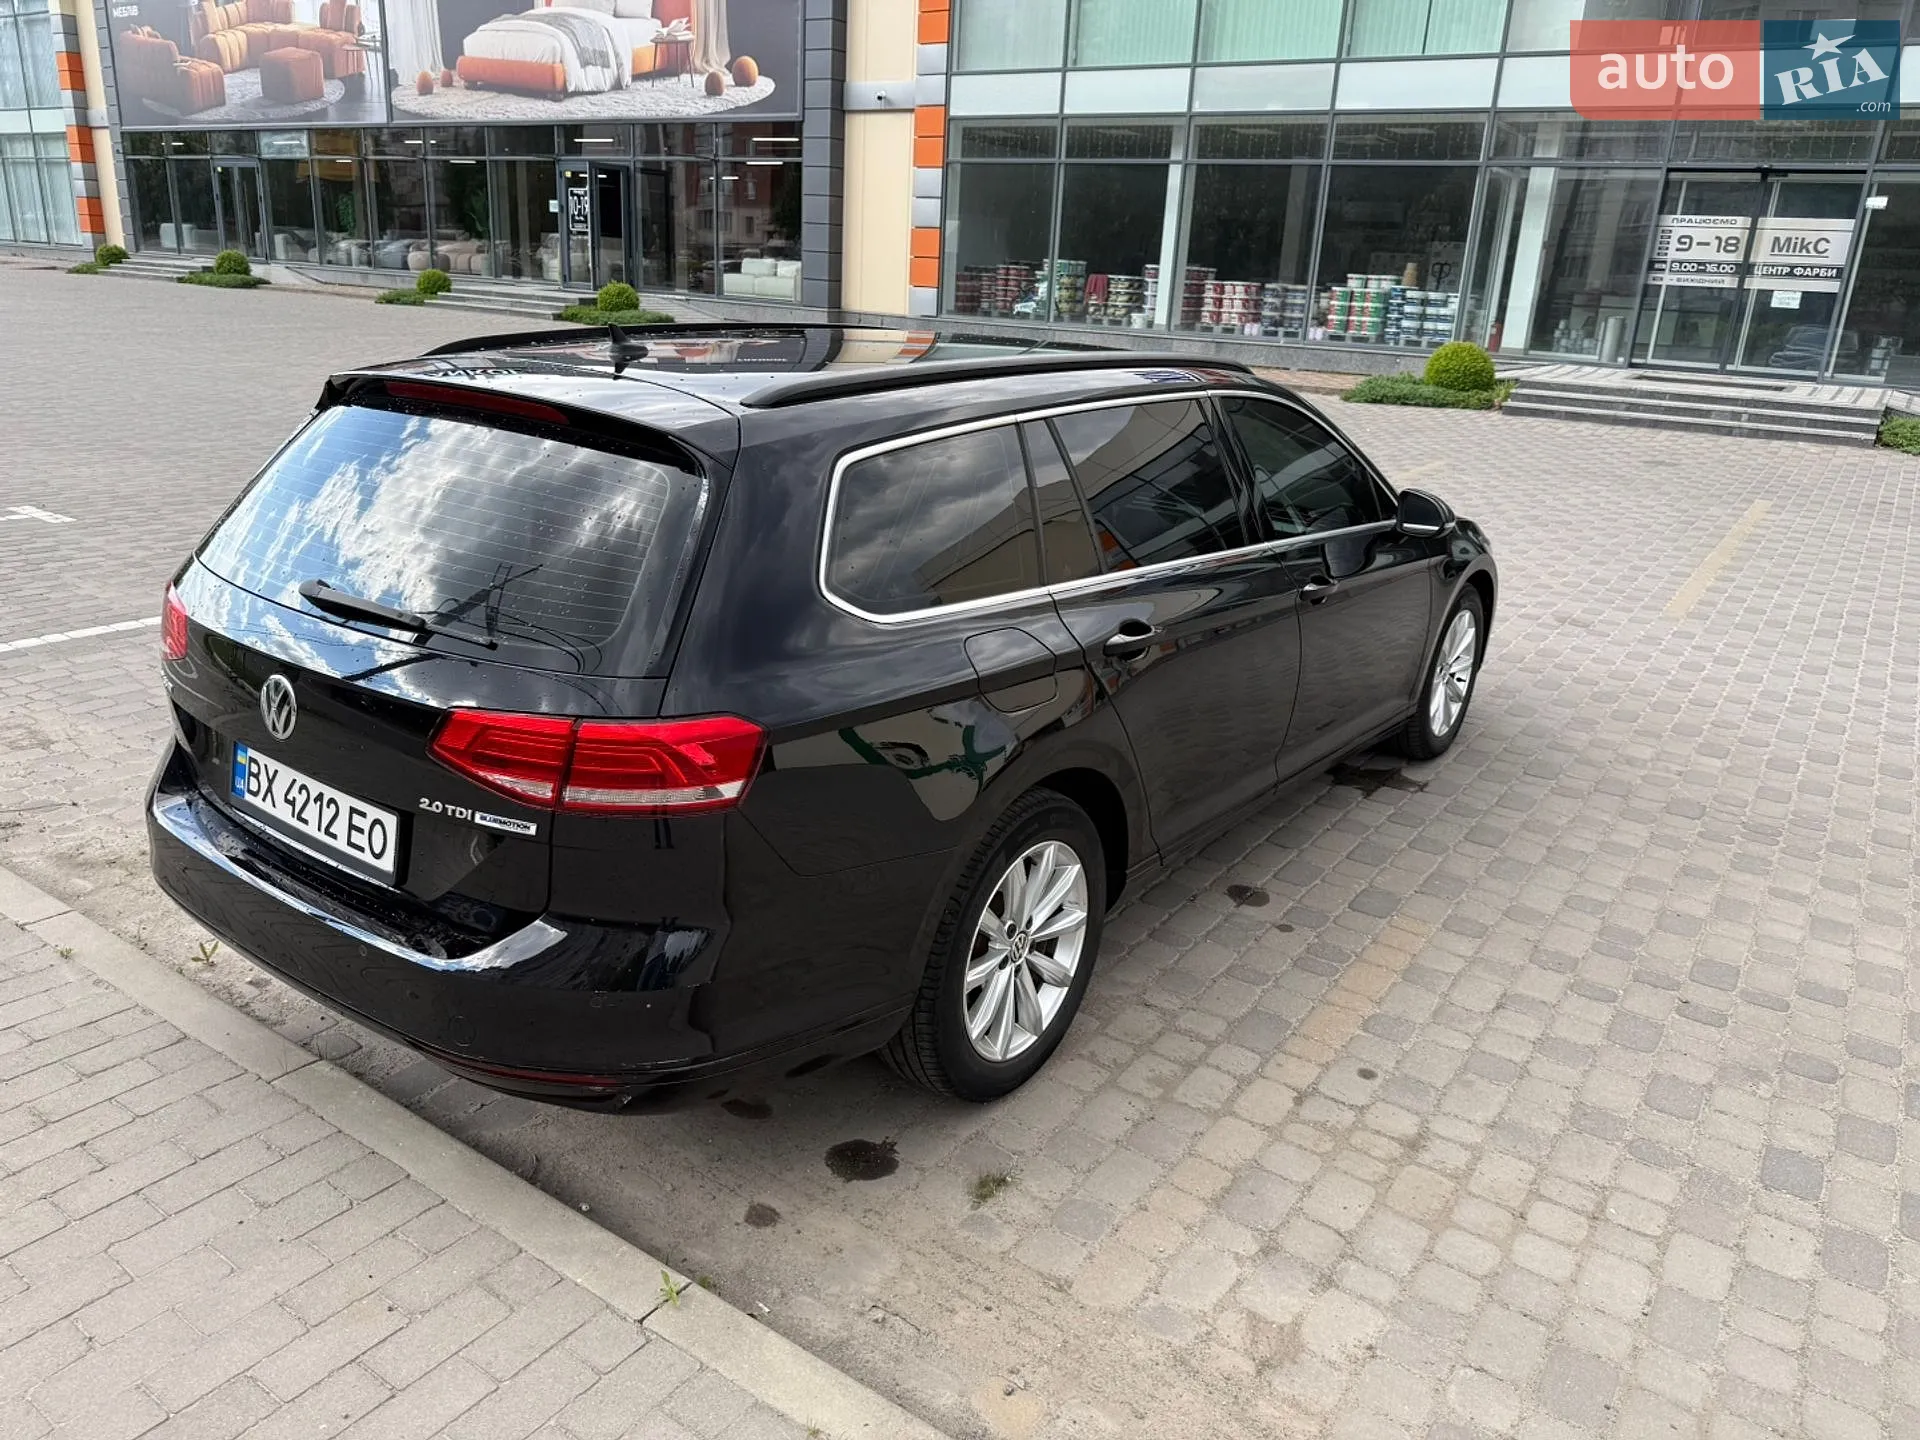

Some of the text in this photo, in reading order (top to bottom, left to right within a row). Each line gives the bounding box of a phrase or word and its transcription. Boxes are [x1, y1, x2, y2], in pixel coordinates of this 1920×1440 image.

[1671, 217, 1738, 226] ПРАЦЮЄМО
[1771, 236, 1831, 254] MikC
[1754, 264, 1837, 277] ЦЕНТР ФАРБИ
[247, 755, 388, 860] BX 4212 EO
[419, 797, 443, 813] 2.0
[445, 804, 472, 820] TDI
